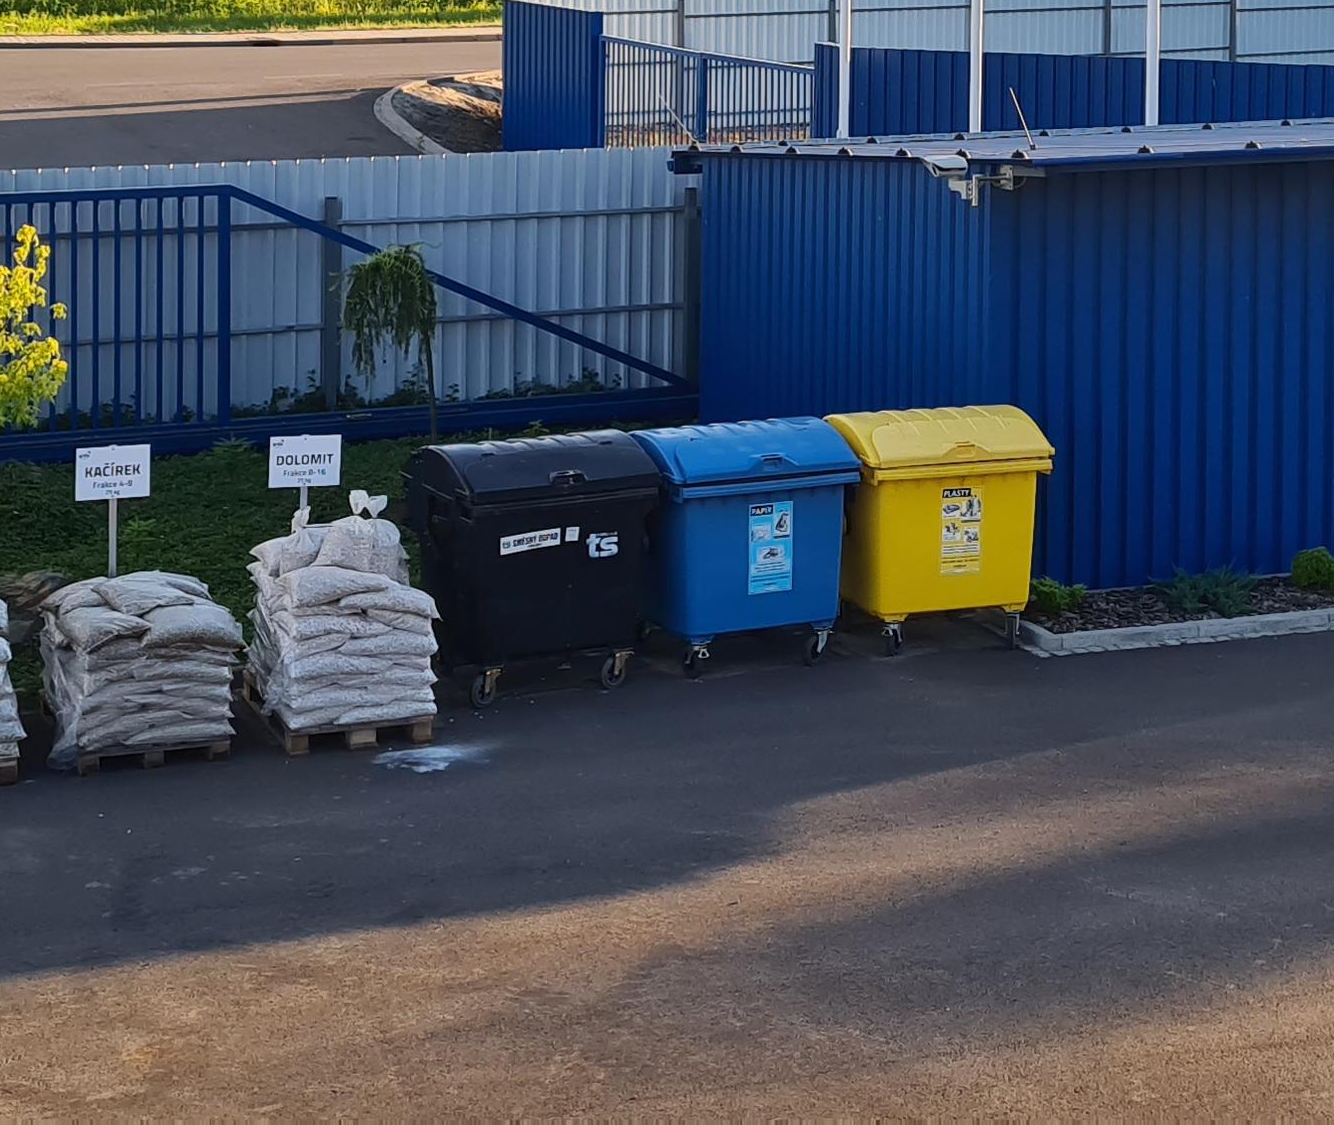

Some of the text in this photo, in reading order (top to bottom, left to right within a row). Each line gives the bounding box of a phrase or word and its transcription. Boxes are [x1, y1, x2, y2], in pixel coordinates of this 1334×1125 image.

[276, 453, 334, 466] DOLOMIT
[84, 462, 141, 478] KAČÍREK
[943, 489, 970, 497] PLASTY
[586, 533, 618, 558] ts
